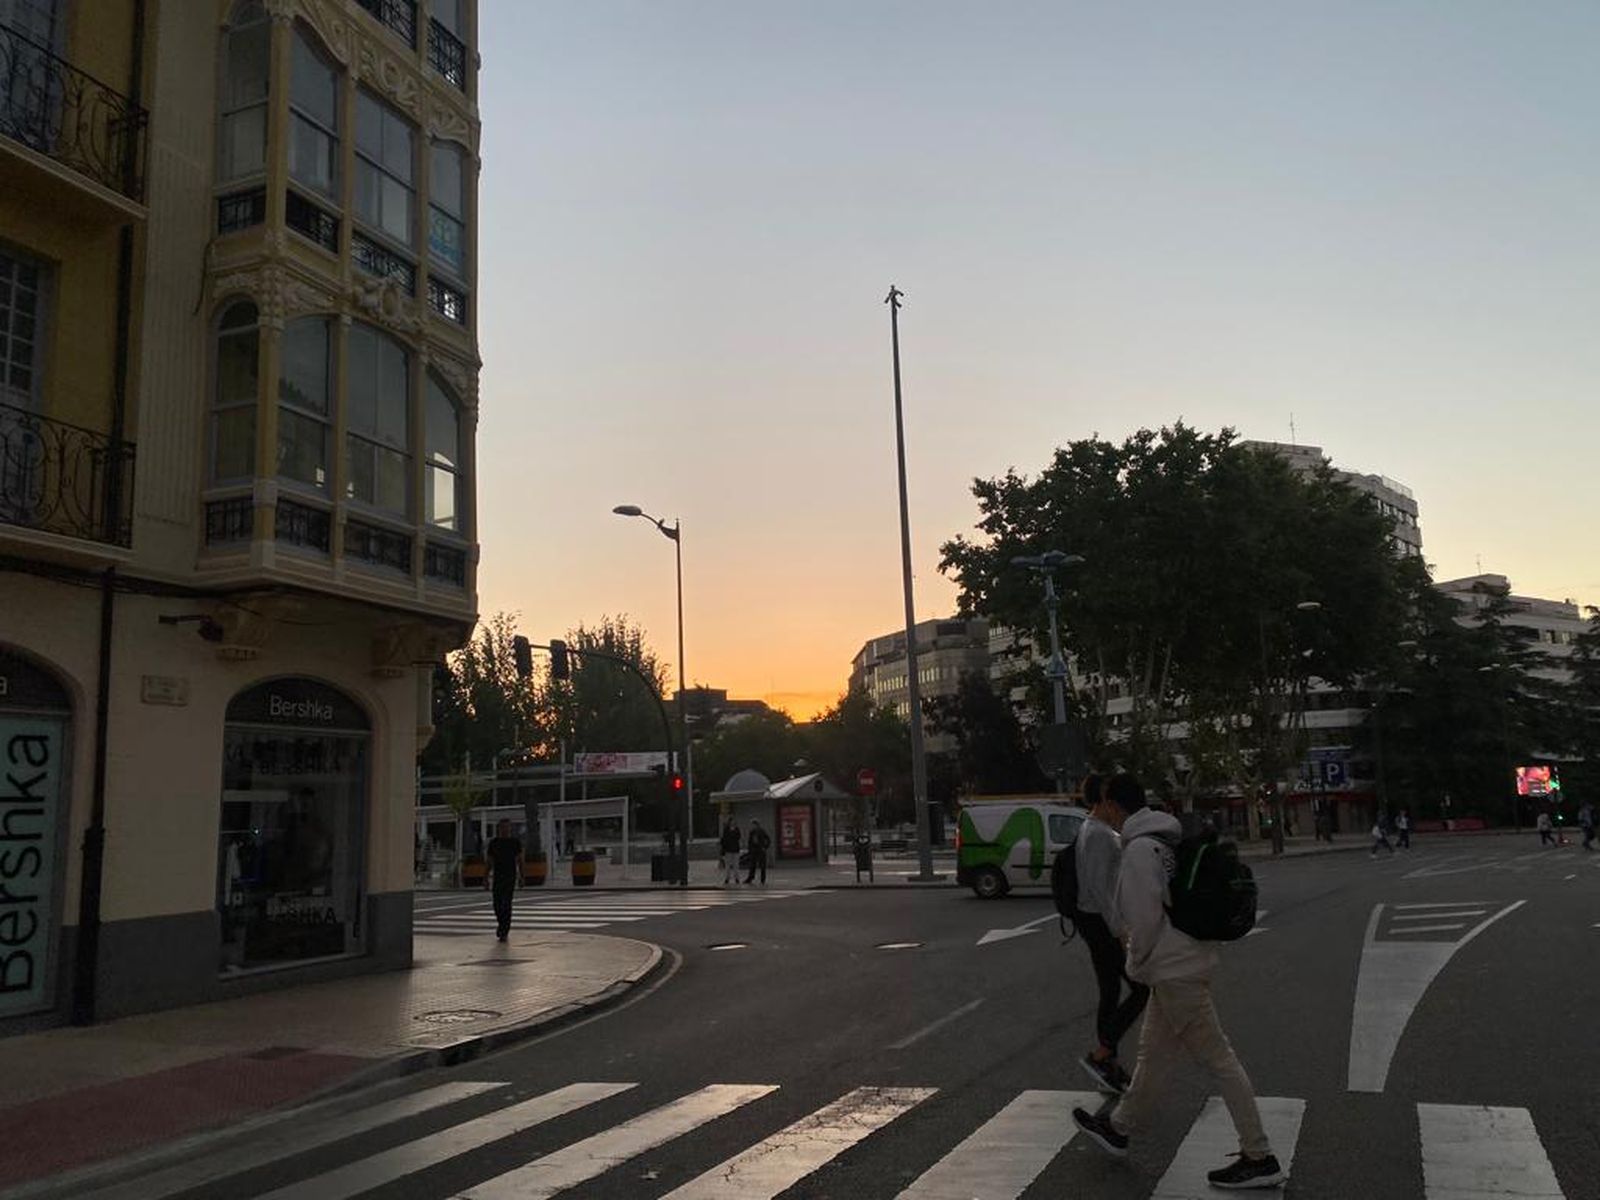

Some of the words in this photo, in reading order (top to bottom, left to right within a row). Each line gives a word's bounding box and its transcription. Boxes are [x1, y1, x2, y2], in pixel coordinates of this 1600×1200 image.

[271, 695, 334, 721] Bershka
[1326, 763, 1340, 782] P
[0, 735, 49, 992] Bershka
